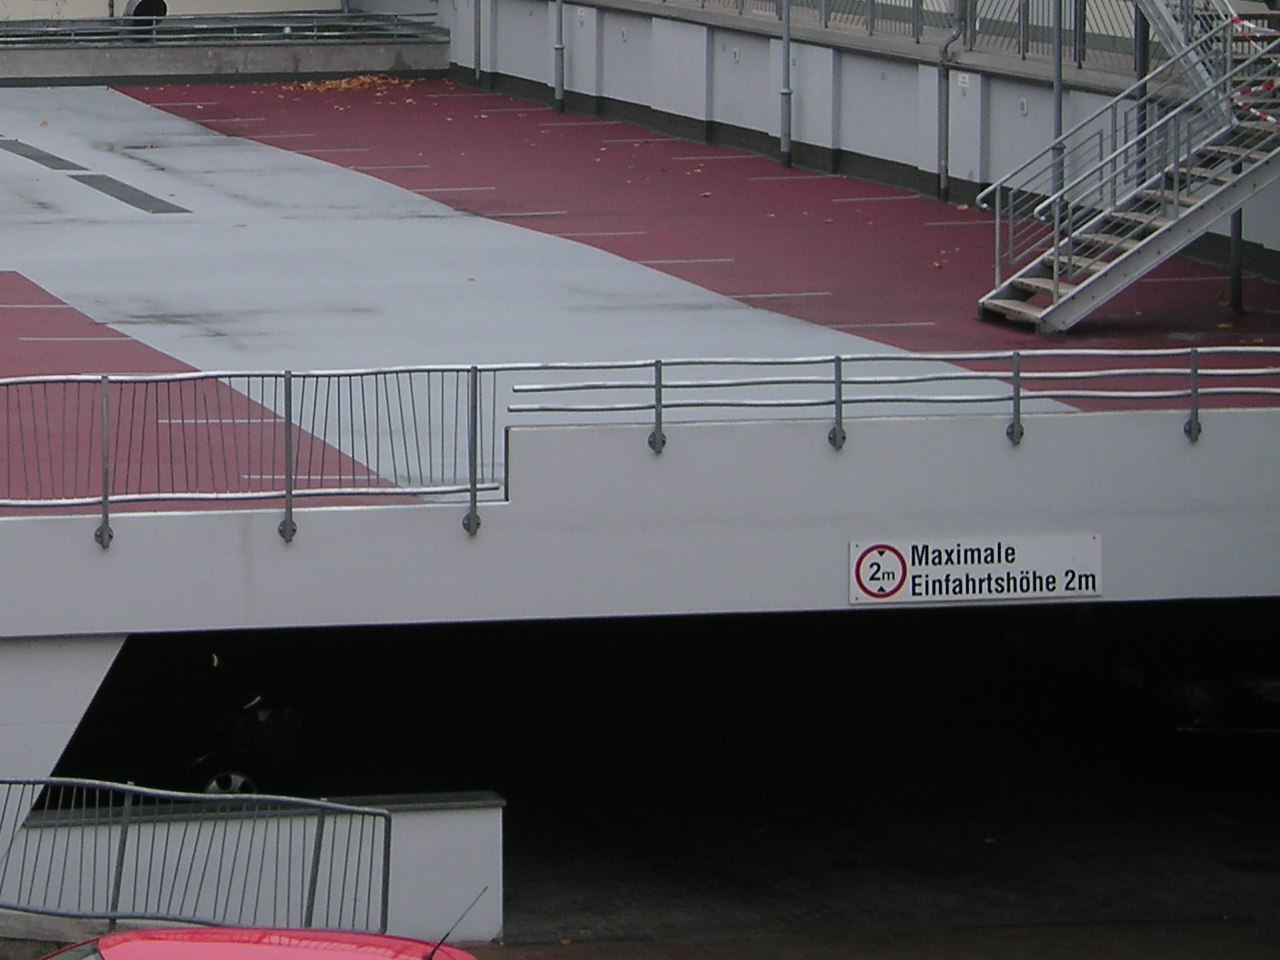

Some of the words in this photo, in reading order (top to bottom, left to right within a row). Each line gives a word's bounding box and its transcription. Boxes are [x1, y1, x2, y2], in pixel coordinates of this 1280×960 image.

[911, 542, 1016, 566] Maximale
[868, 562, 895, 581] 2m
[911, 571, 1056, 596] Einfahrtshöhe
[1064, 570, 1097, 592] 2m
